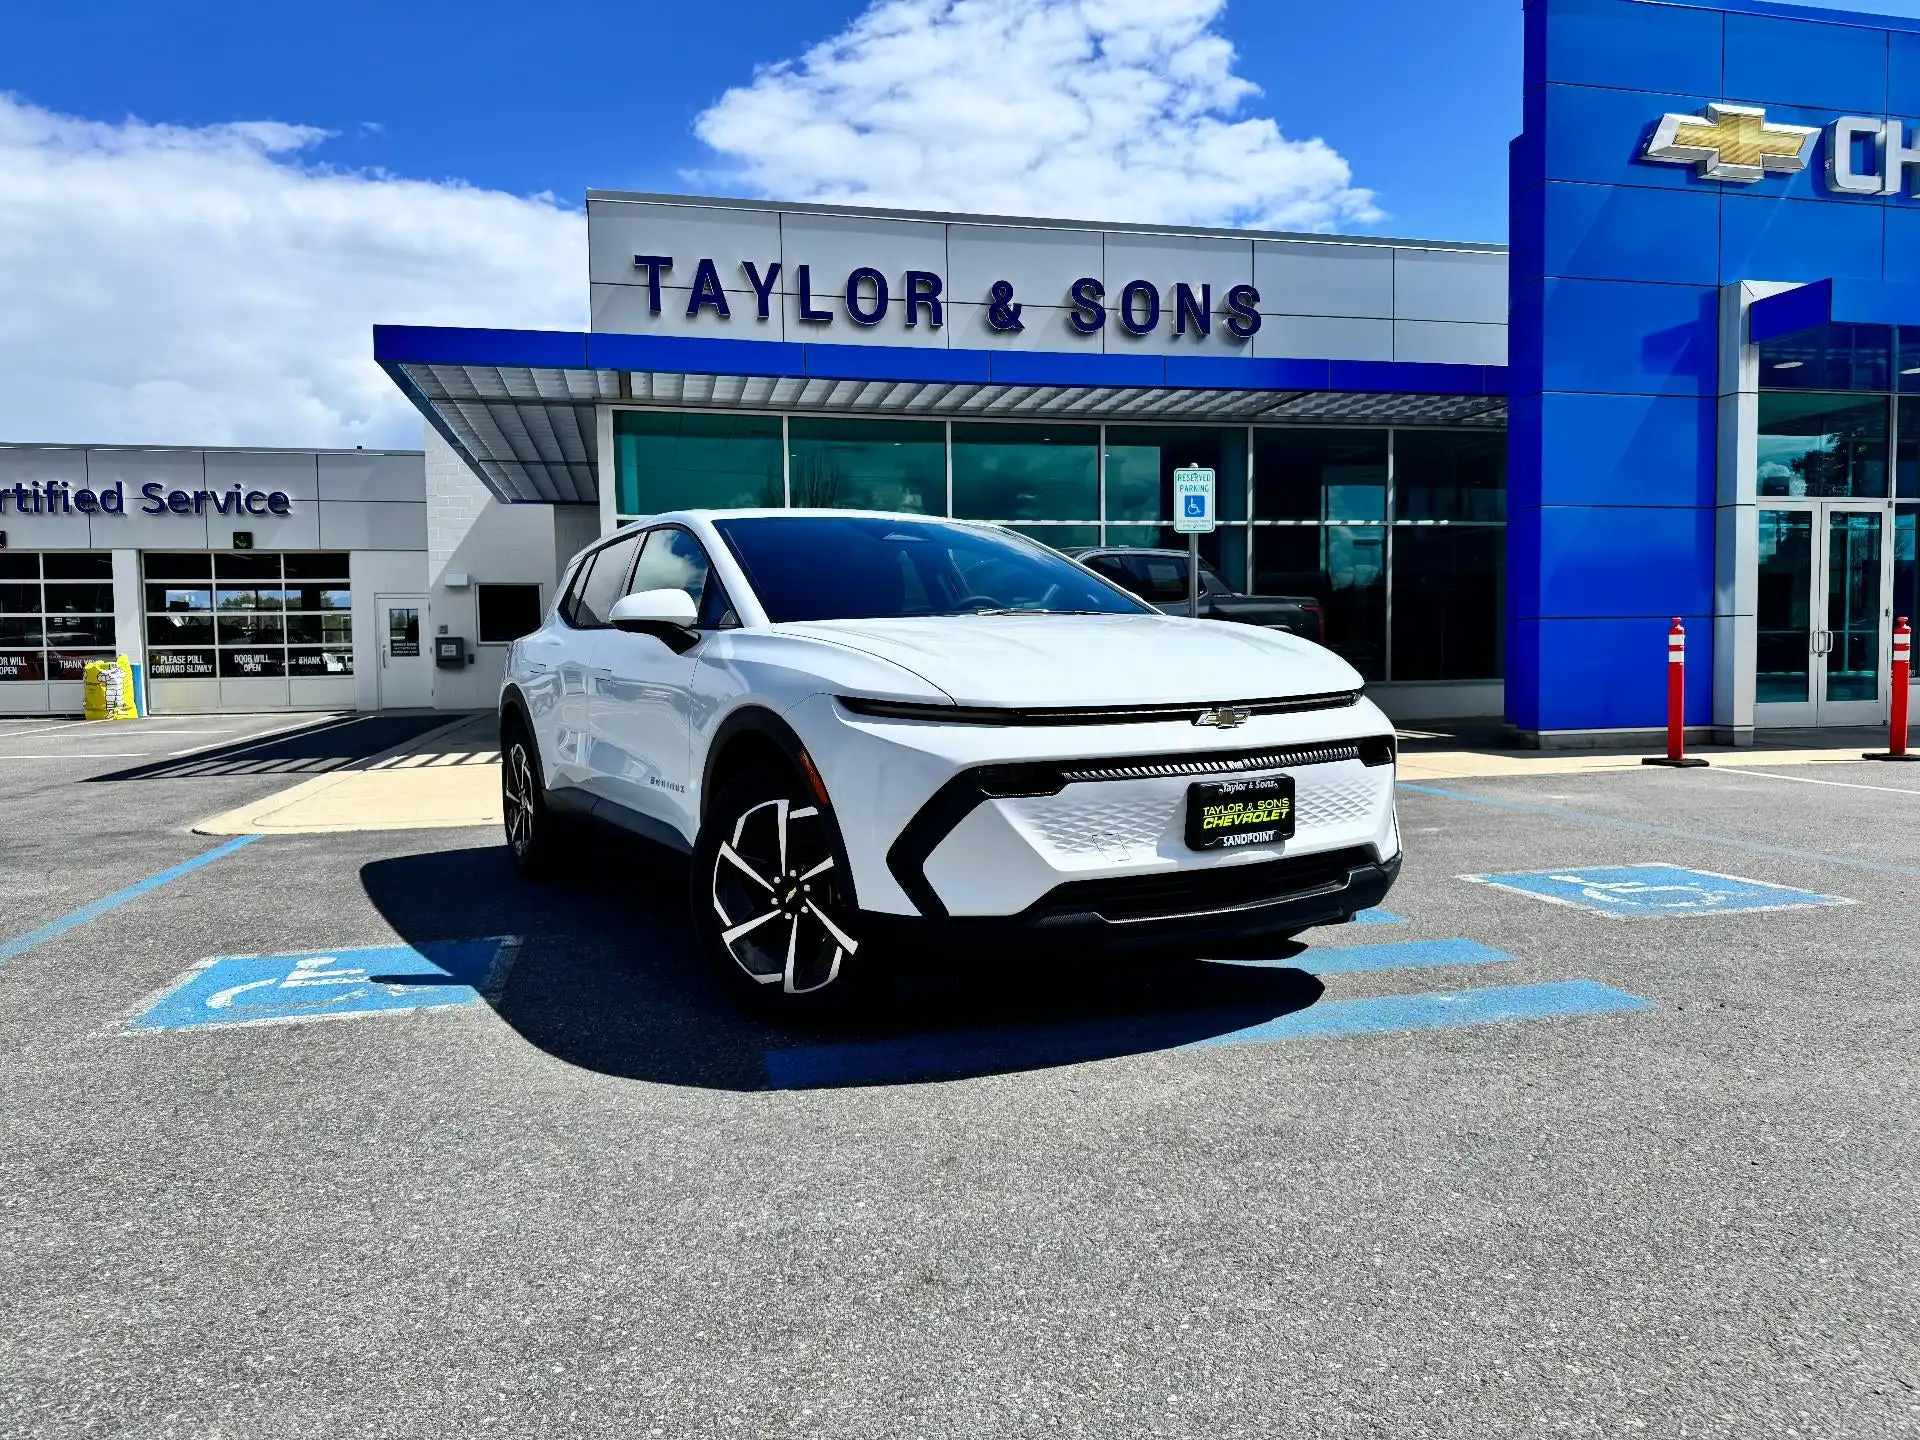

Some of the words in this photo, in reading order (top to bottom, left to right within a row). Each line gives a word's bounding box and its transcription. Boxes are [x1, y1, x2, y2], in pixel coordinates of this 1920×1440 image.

[633, 253, 944, 329] TAYLOR
[986, 279, 1024, 332] &
[1069, 276, 1263, 339] SONS
[1177, 473, 1211, 482] RESERVED
[1179, 484, 1210, 493] PARKING
[141, 482, 290, 515] Service
[10, 656, 28, 666] WILL
[160, 655, 187, 664] PLEASE
[187, 654, 205, 664] PULL
[253, 653, 271, 663] WILL
[298, 655, 321, 665] THANK
[58, 660, 83, 669] THANK
[151, 664, 185, 674] FORWARD
[186, 664, 213, 673] SLOWLY
[243, 662, 262, 673] OPEN
[0, 666, 18, 675] OPEN
[1222, 782, 1247, 795] Taylor
[1248, 781, 1254, 789] &
[1255, 780, 1275, 789] Sons
[1202, 802, 1244, 816] TAYLOR
[1246, 802, 1254, 812] &
[1257, 797, 1290, 810] SONS
[1202, 808, 1290, 830] CHEVROLET
[1222, 830, 1275, 847] SANDPOINT
